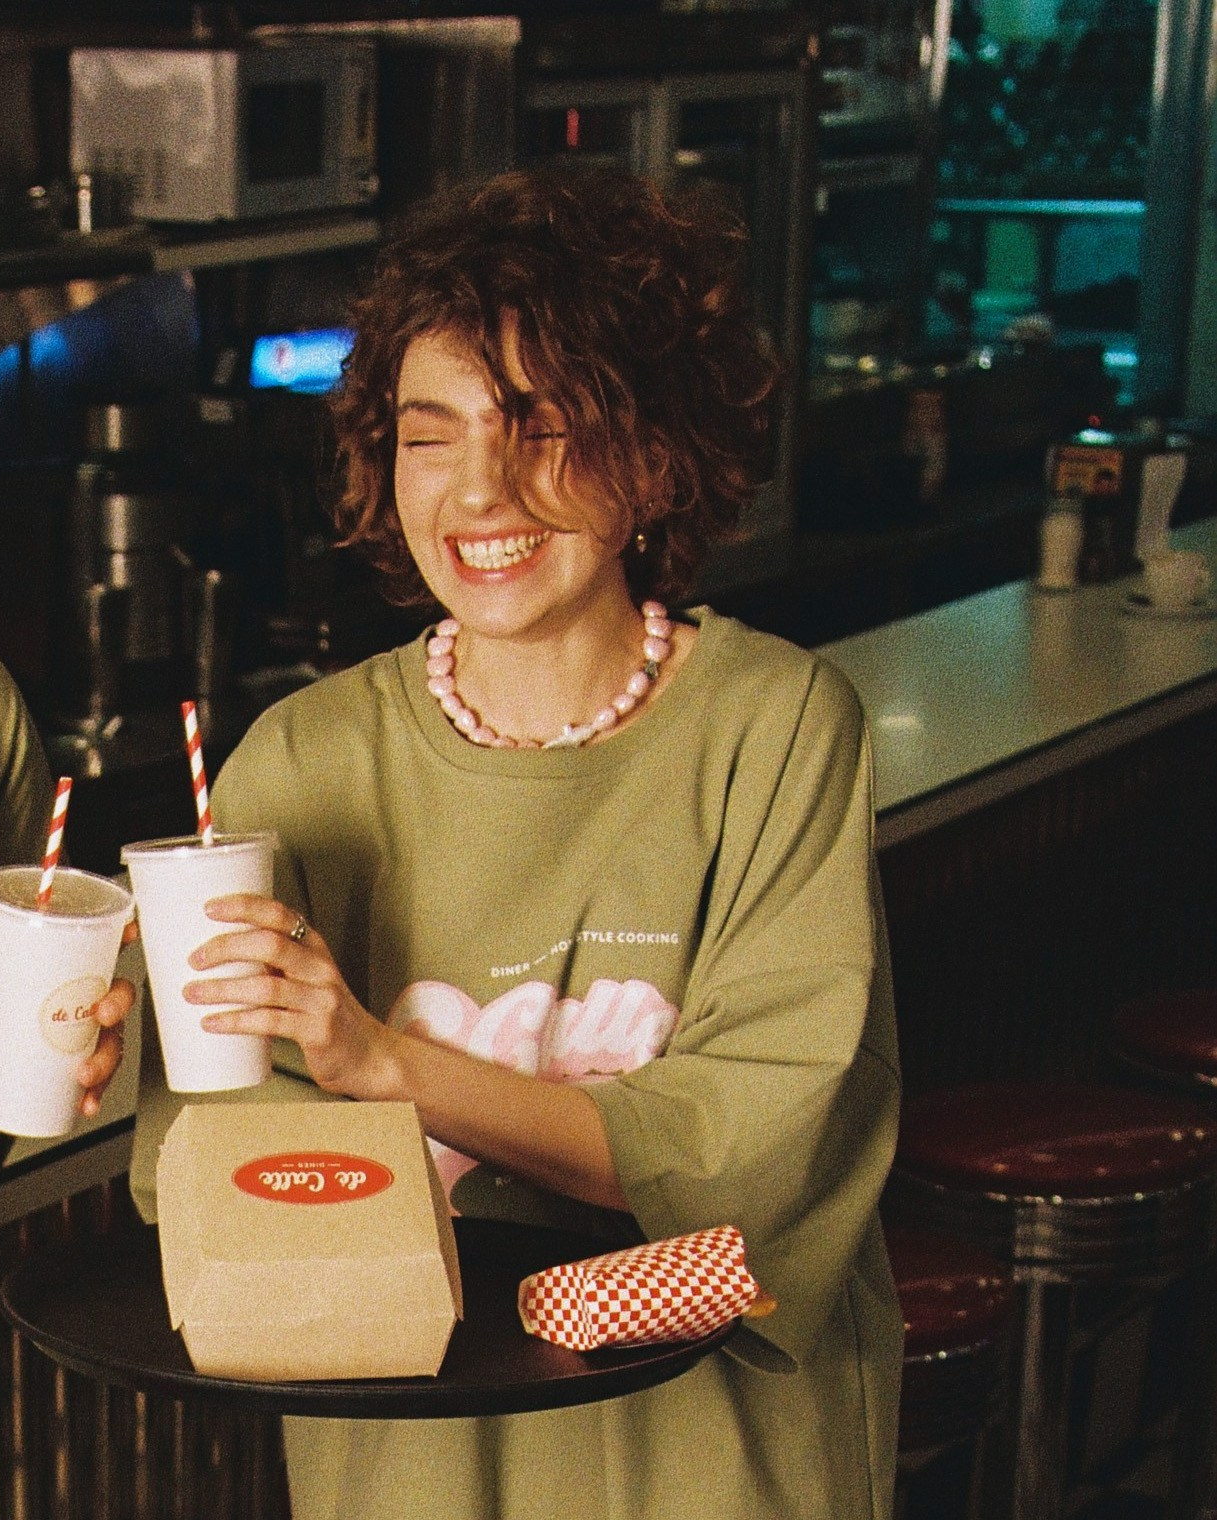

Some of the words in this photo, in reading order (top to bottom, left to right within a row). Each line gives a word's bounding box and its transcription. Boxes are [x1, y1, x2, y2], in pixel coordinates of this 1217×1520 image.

[490, 961, 531, 978] DINER
[616, 931, 679, 944] COOKING
[258, 1170, 326, 1193] Calle
